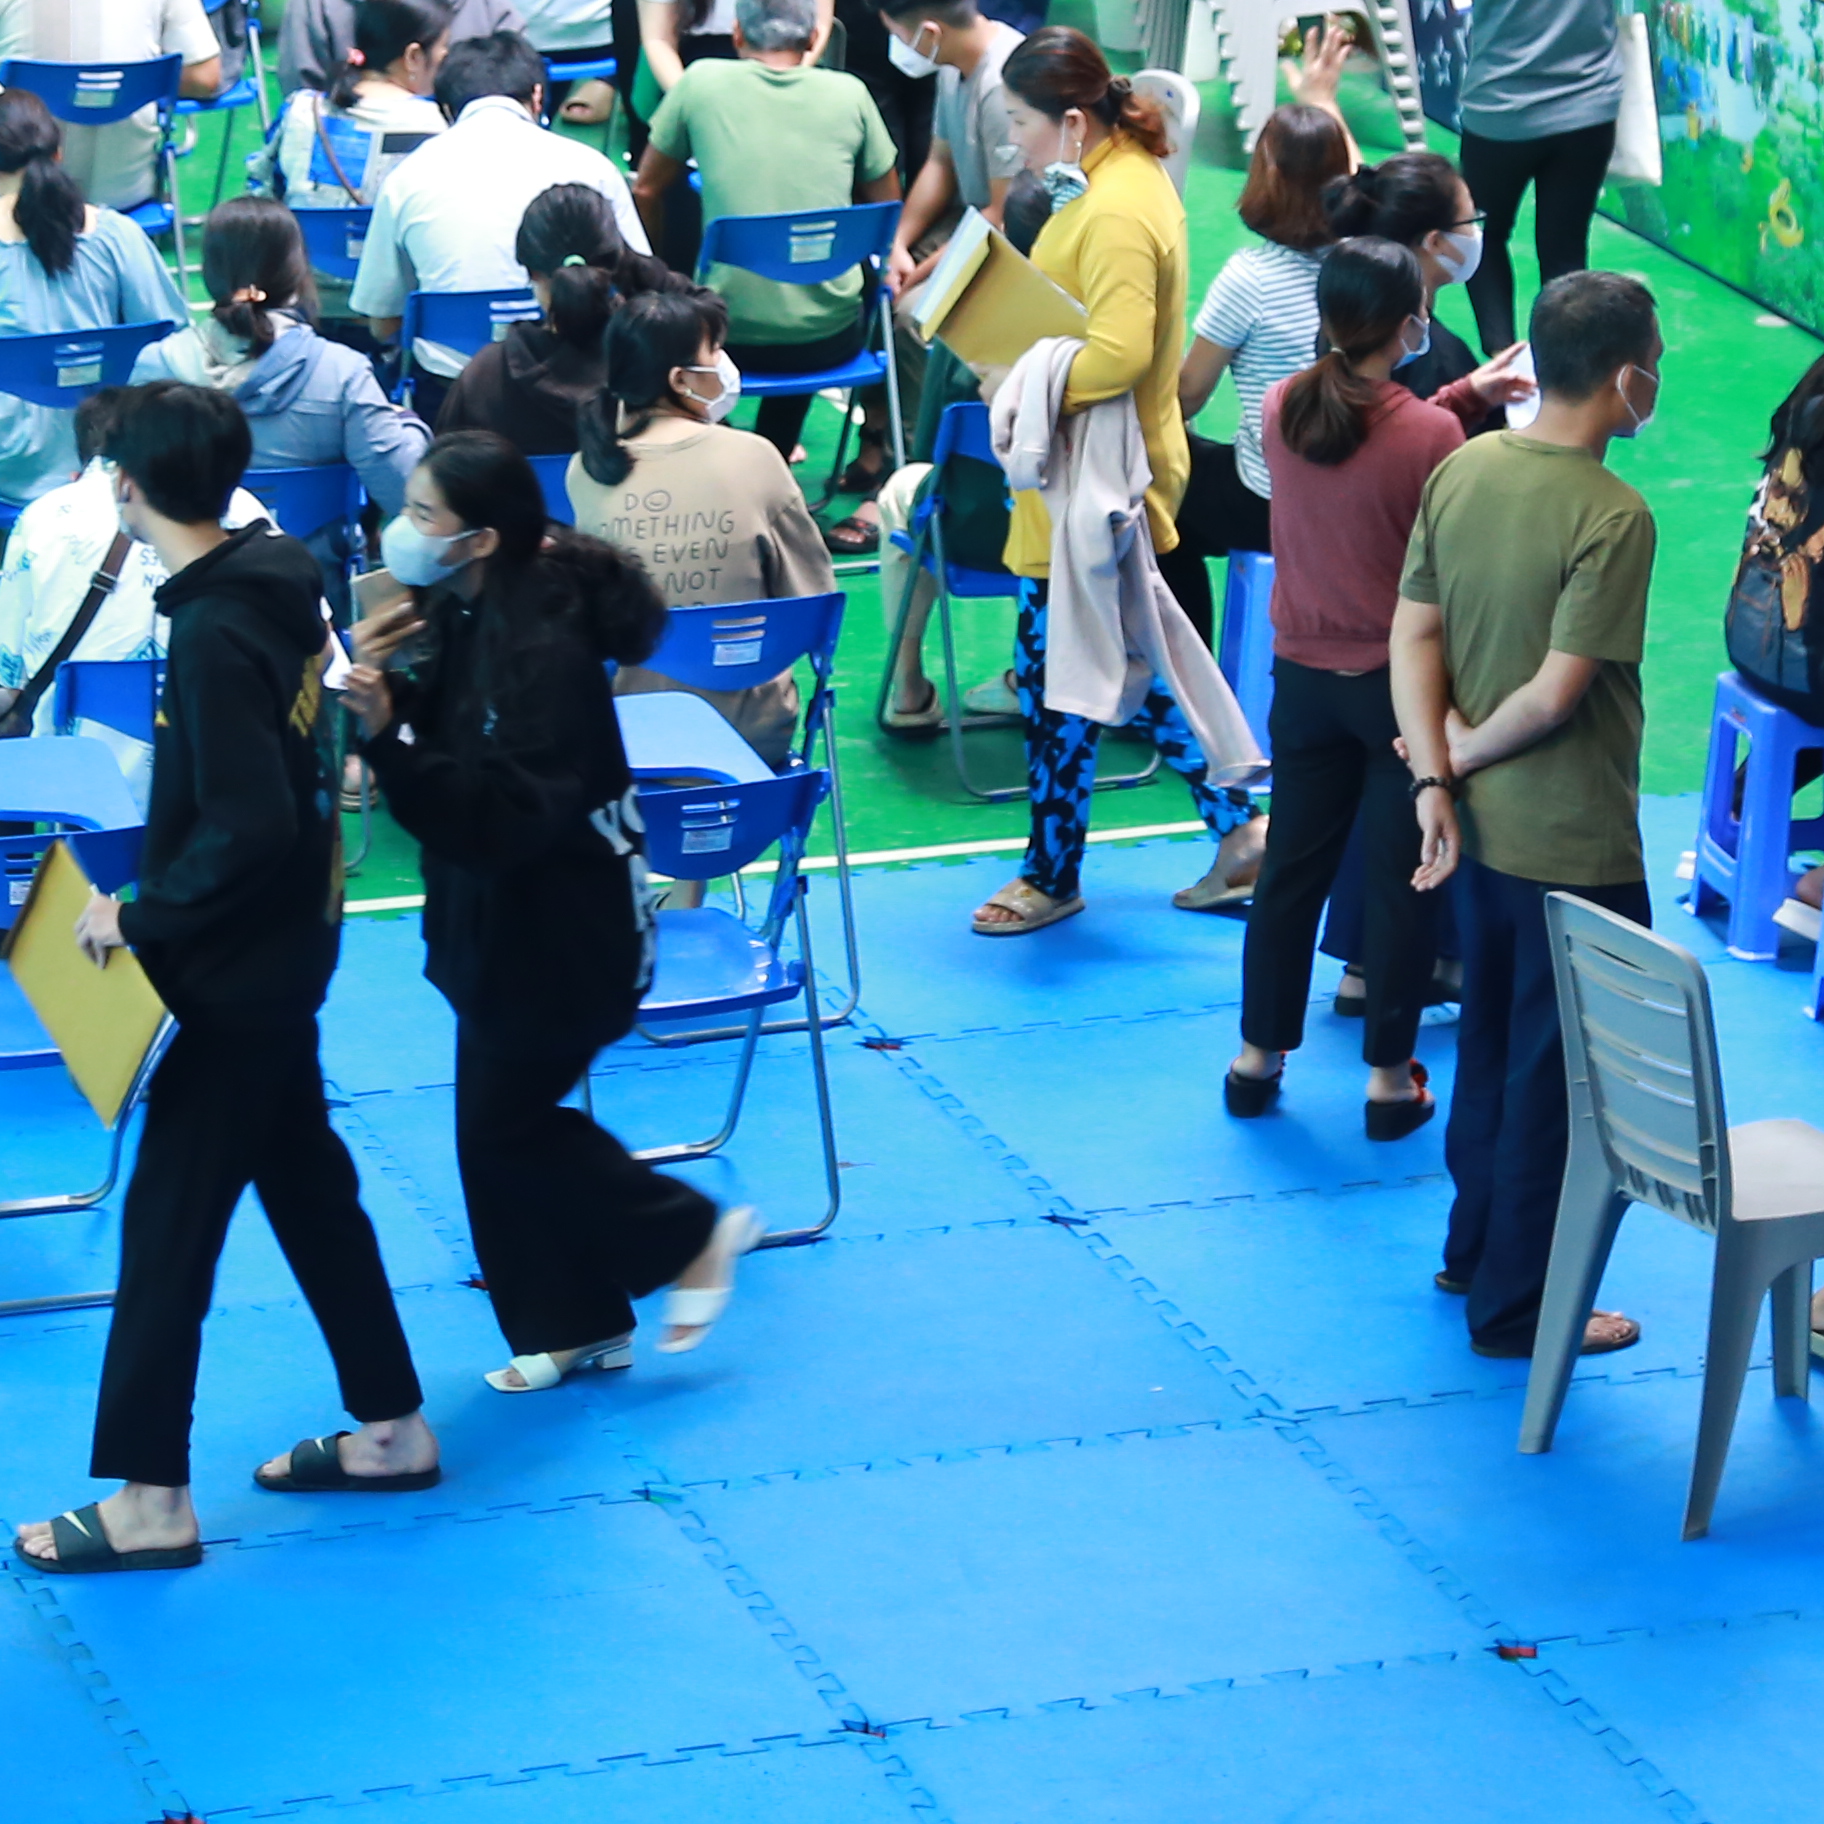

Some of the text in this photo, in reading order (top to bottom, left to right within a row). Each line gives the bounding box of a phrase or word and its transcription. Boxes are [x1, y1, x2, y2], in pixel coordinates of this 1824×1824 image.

[601, 510, 735, 540] METHING
[653, 538, 729, 564] EVEN
[663, 568, 723, 594] NOT
